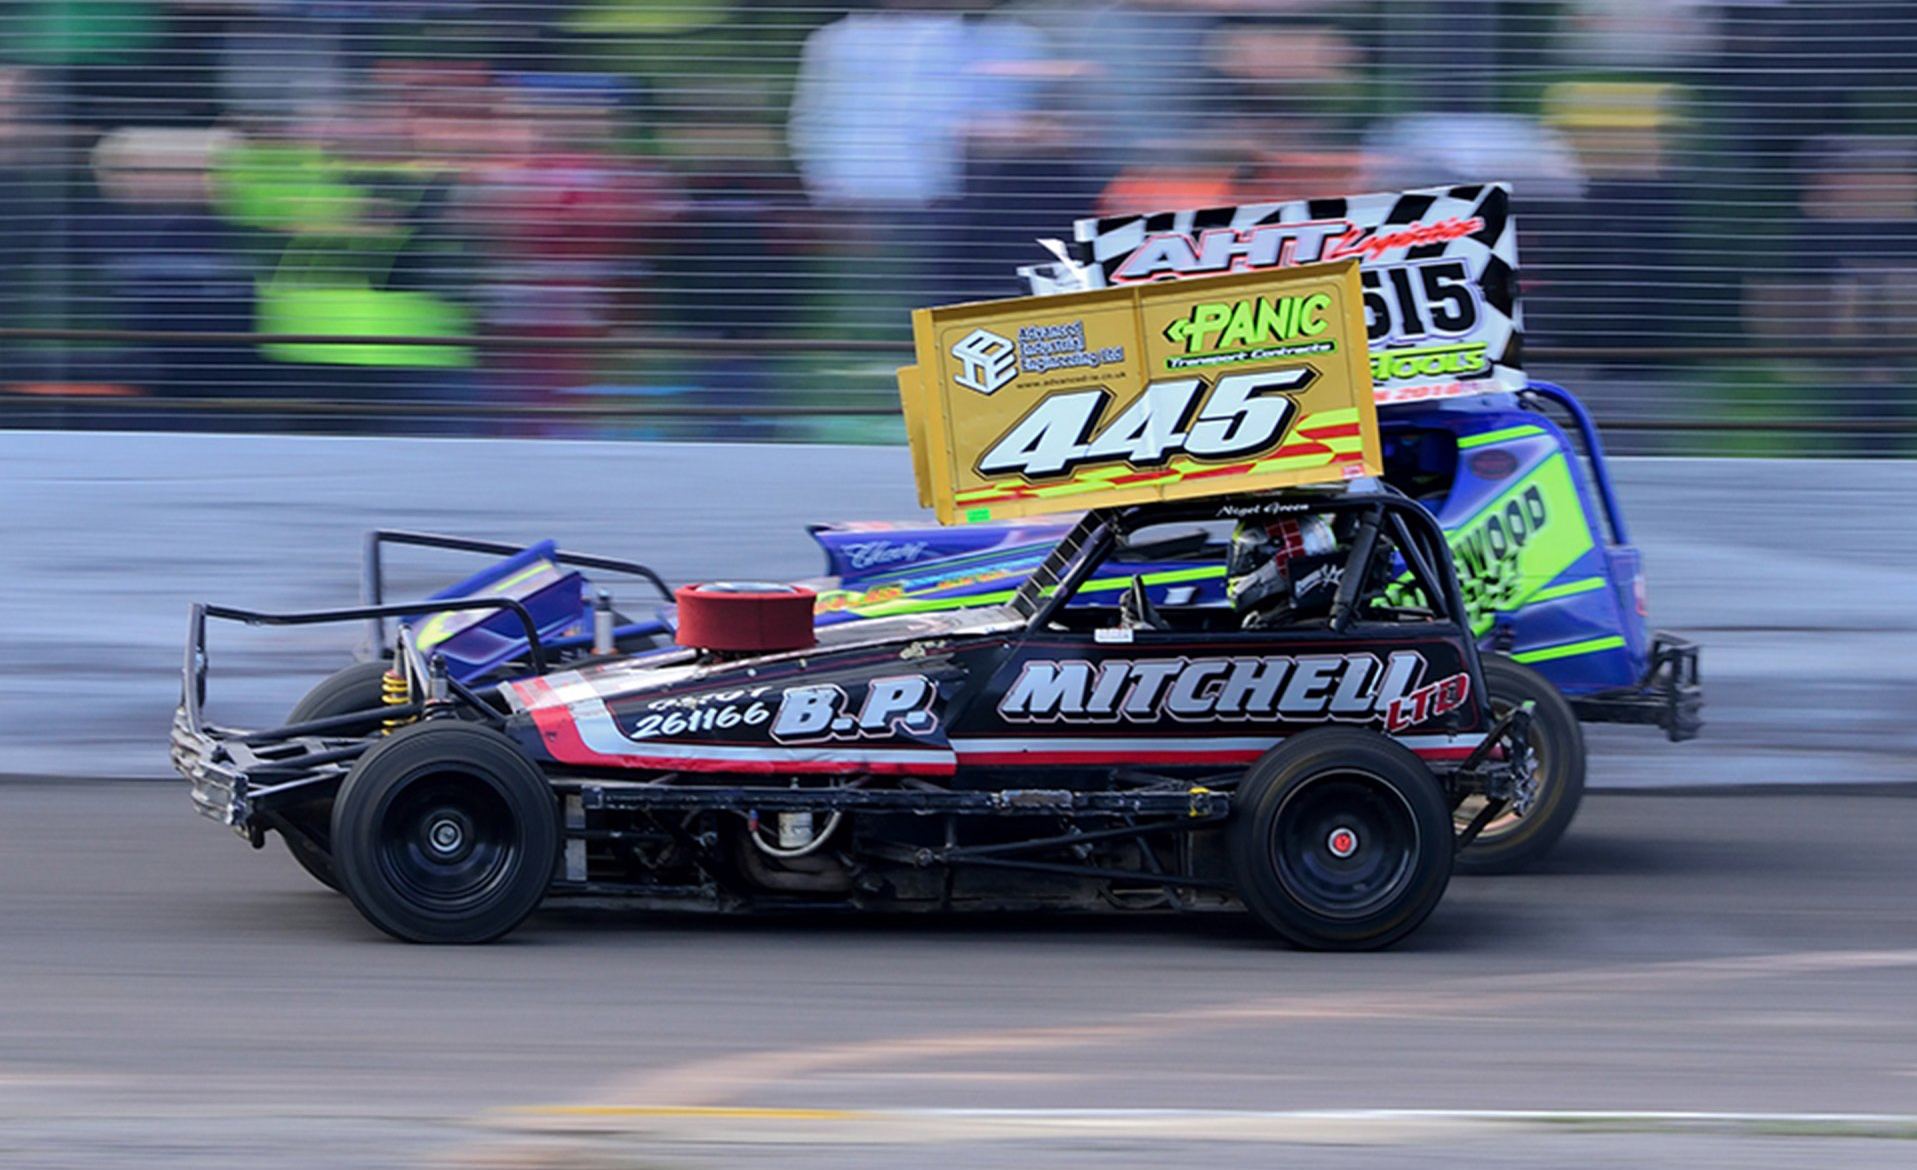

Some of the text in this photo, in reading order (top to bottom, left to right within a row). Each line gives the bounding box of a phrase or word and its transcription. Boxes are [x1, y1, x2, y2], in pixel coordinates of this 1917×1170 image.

[1110, 219, 1354, 283] AHT
[1018, 320, 1083, 341] Advanced
[1182, 293, 1332, 354] PANIC
[1361, 261, 1477, 341] 515
[1018, 337, 1086, 357] Industrial
[1021, 351, 1100, 374] Engineering
[1169, 351, 1249, 369] Transport
[975, 367, 1322, 484] 445
[1216, 501, 1310, 517] Nigel Green
[769, 674, 939, 745] B.P.
[999, 651, 1428, 724] MITCHELL
[1385, 672, 1470, 733] LTD
[630, 701, 770, 739] 261166
